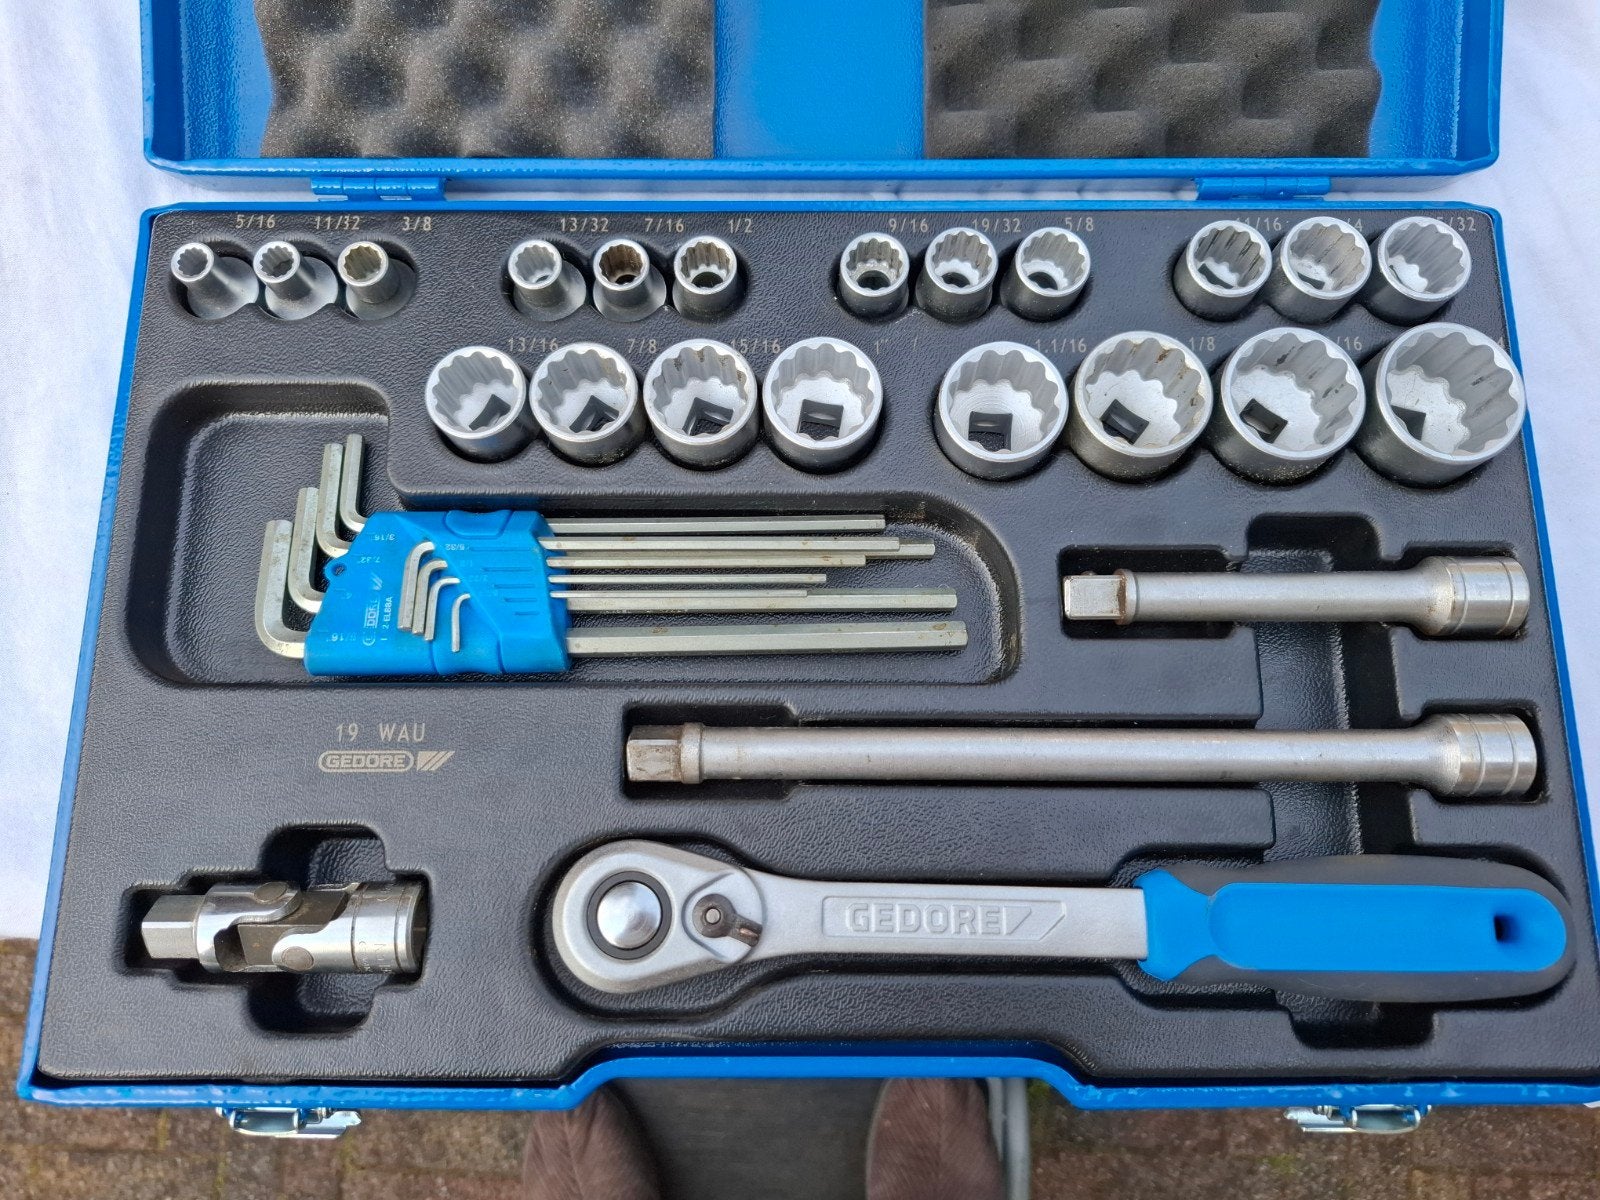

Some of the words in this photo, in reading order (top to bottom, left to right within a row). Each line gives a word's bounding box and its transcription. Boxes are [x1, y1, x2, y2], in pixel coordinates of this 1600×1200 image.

[235, 214, 276, 229] 5/16
[314, 215, 361, 230] 11/32
[402, 216, 432, 231] 3/8
[560, 217, 609, 232] 13/32
[644, 218, 684, 233] 7/16
[728, 219, 754, 234] 1/2
[888, 218, 929, 233] 9/16
[971, 218, 1022, 233] 19/32
[1064, 216, 1095, 232] 5/8
[507, 337, 559, 352] 13/16
[627, 338, 657, 353] 7/8
[336, 722, 359, 742] 19
[379, 722, 426, 742] WAU
[325, 754, 406, 769] GEDORE
[846, 902, 1001, 935] GEDORE
